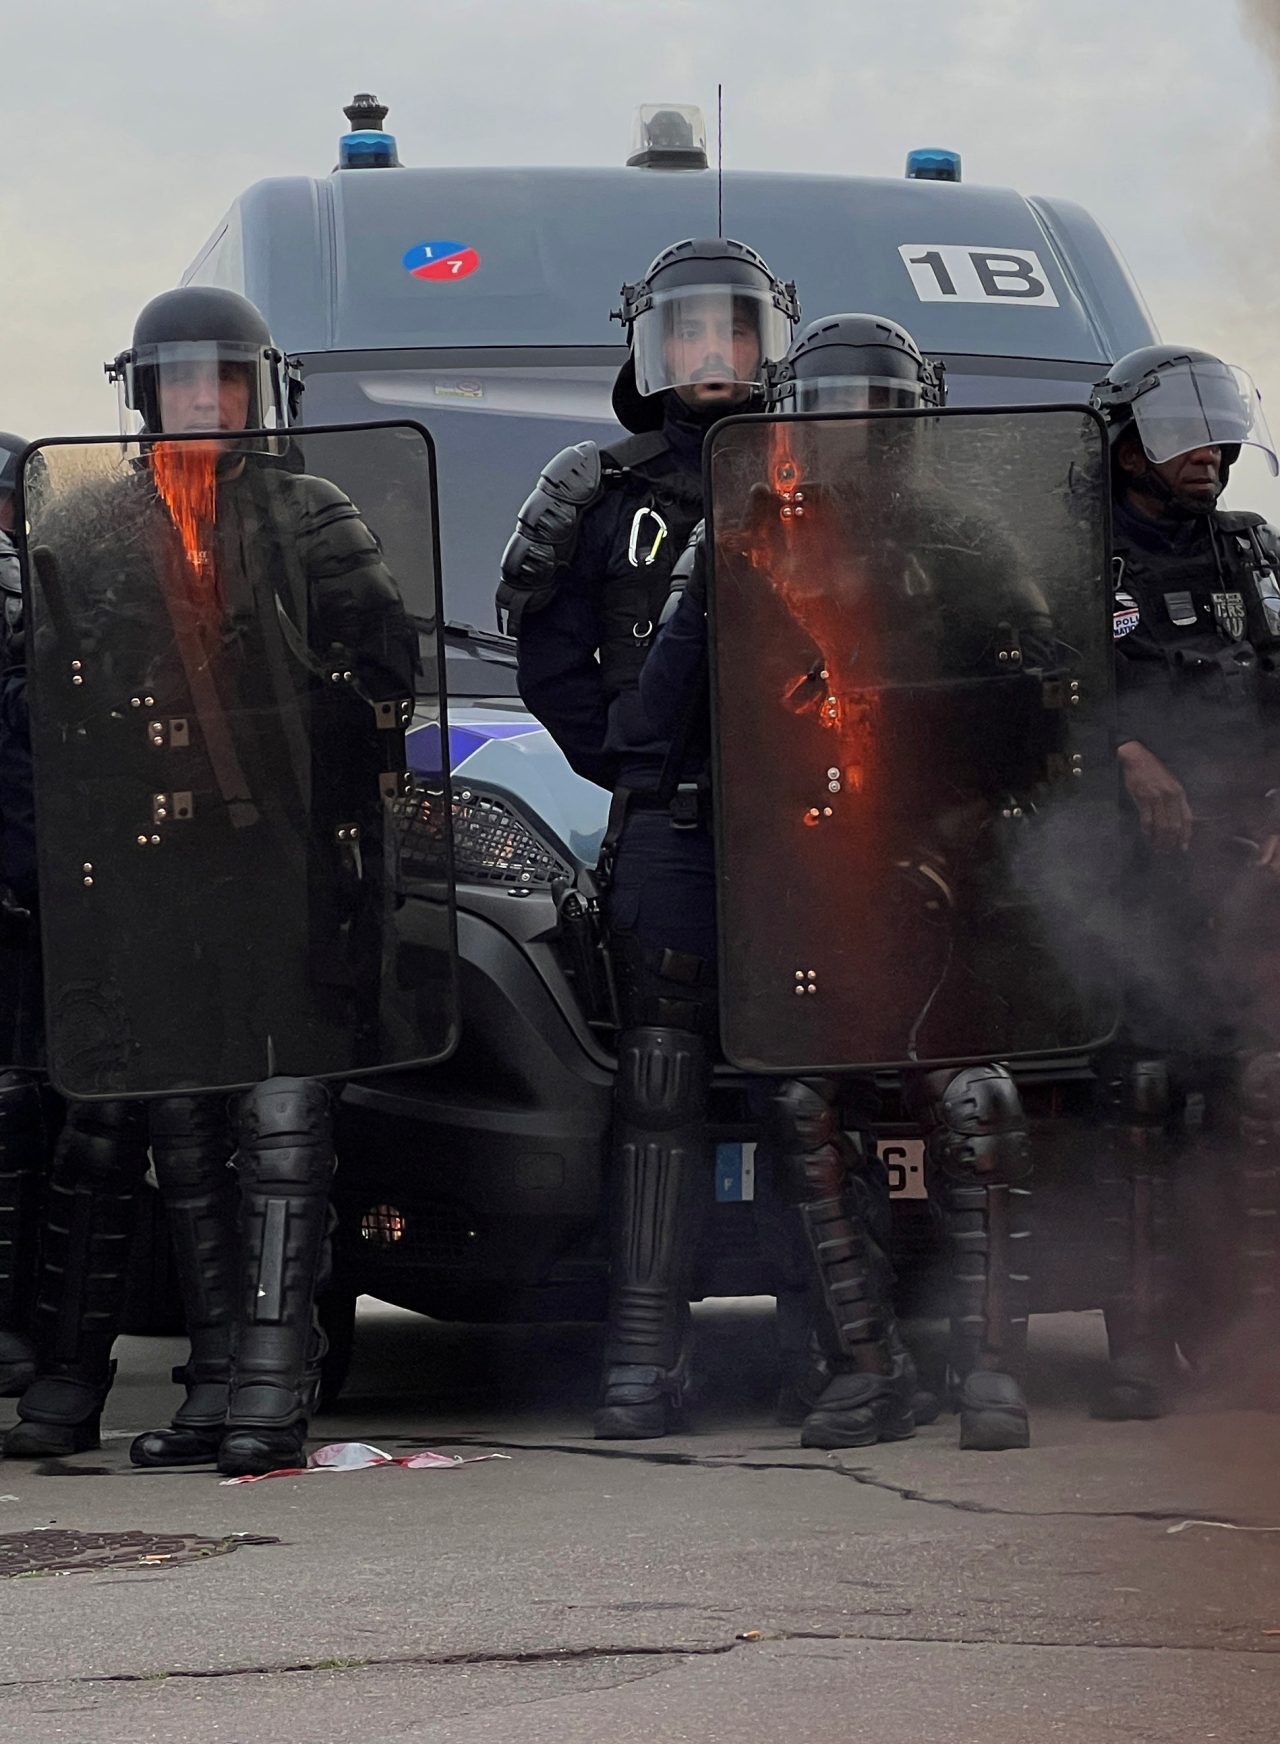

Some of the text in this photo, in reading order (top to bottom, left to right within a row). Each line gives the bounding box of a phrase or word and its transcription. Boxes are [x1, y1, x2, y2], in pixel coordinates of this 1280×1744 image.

[446, 260, 463, 273] 7
[909, 251, 1045, 298] 1B
[1115, 615, 1139, 628] POLI
